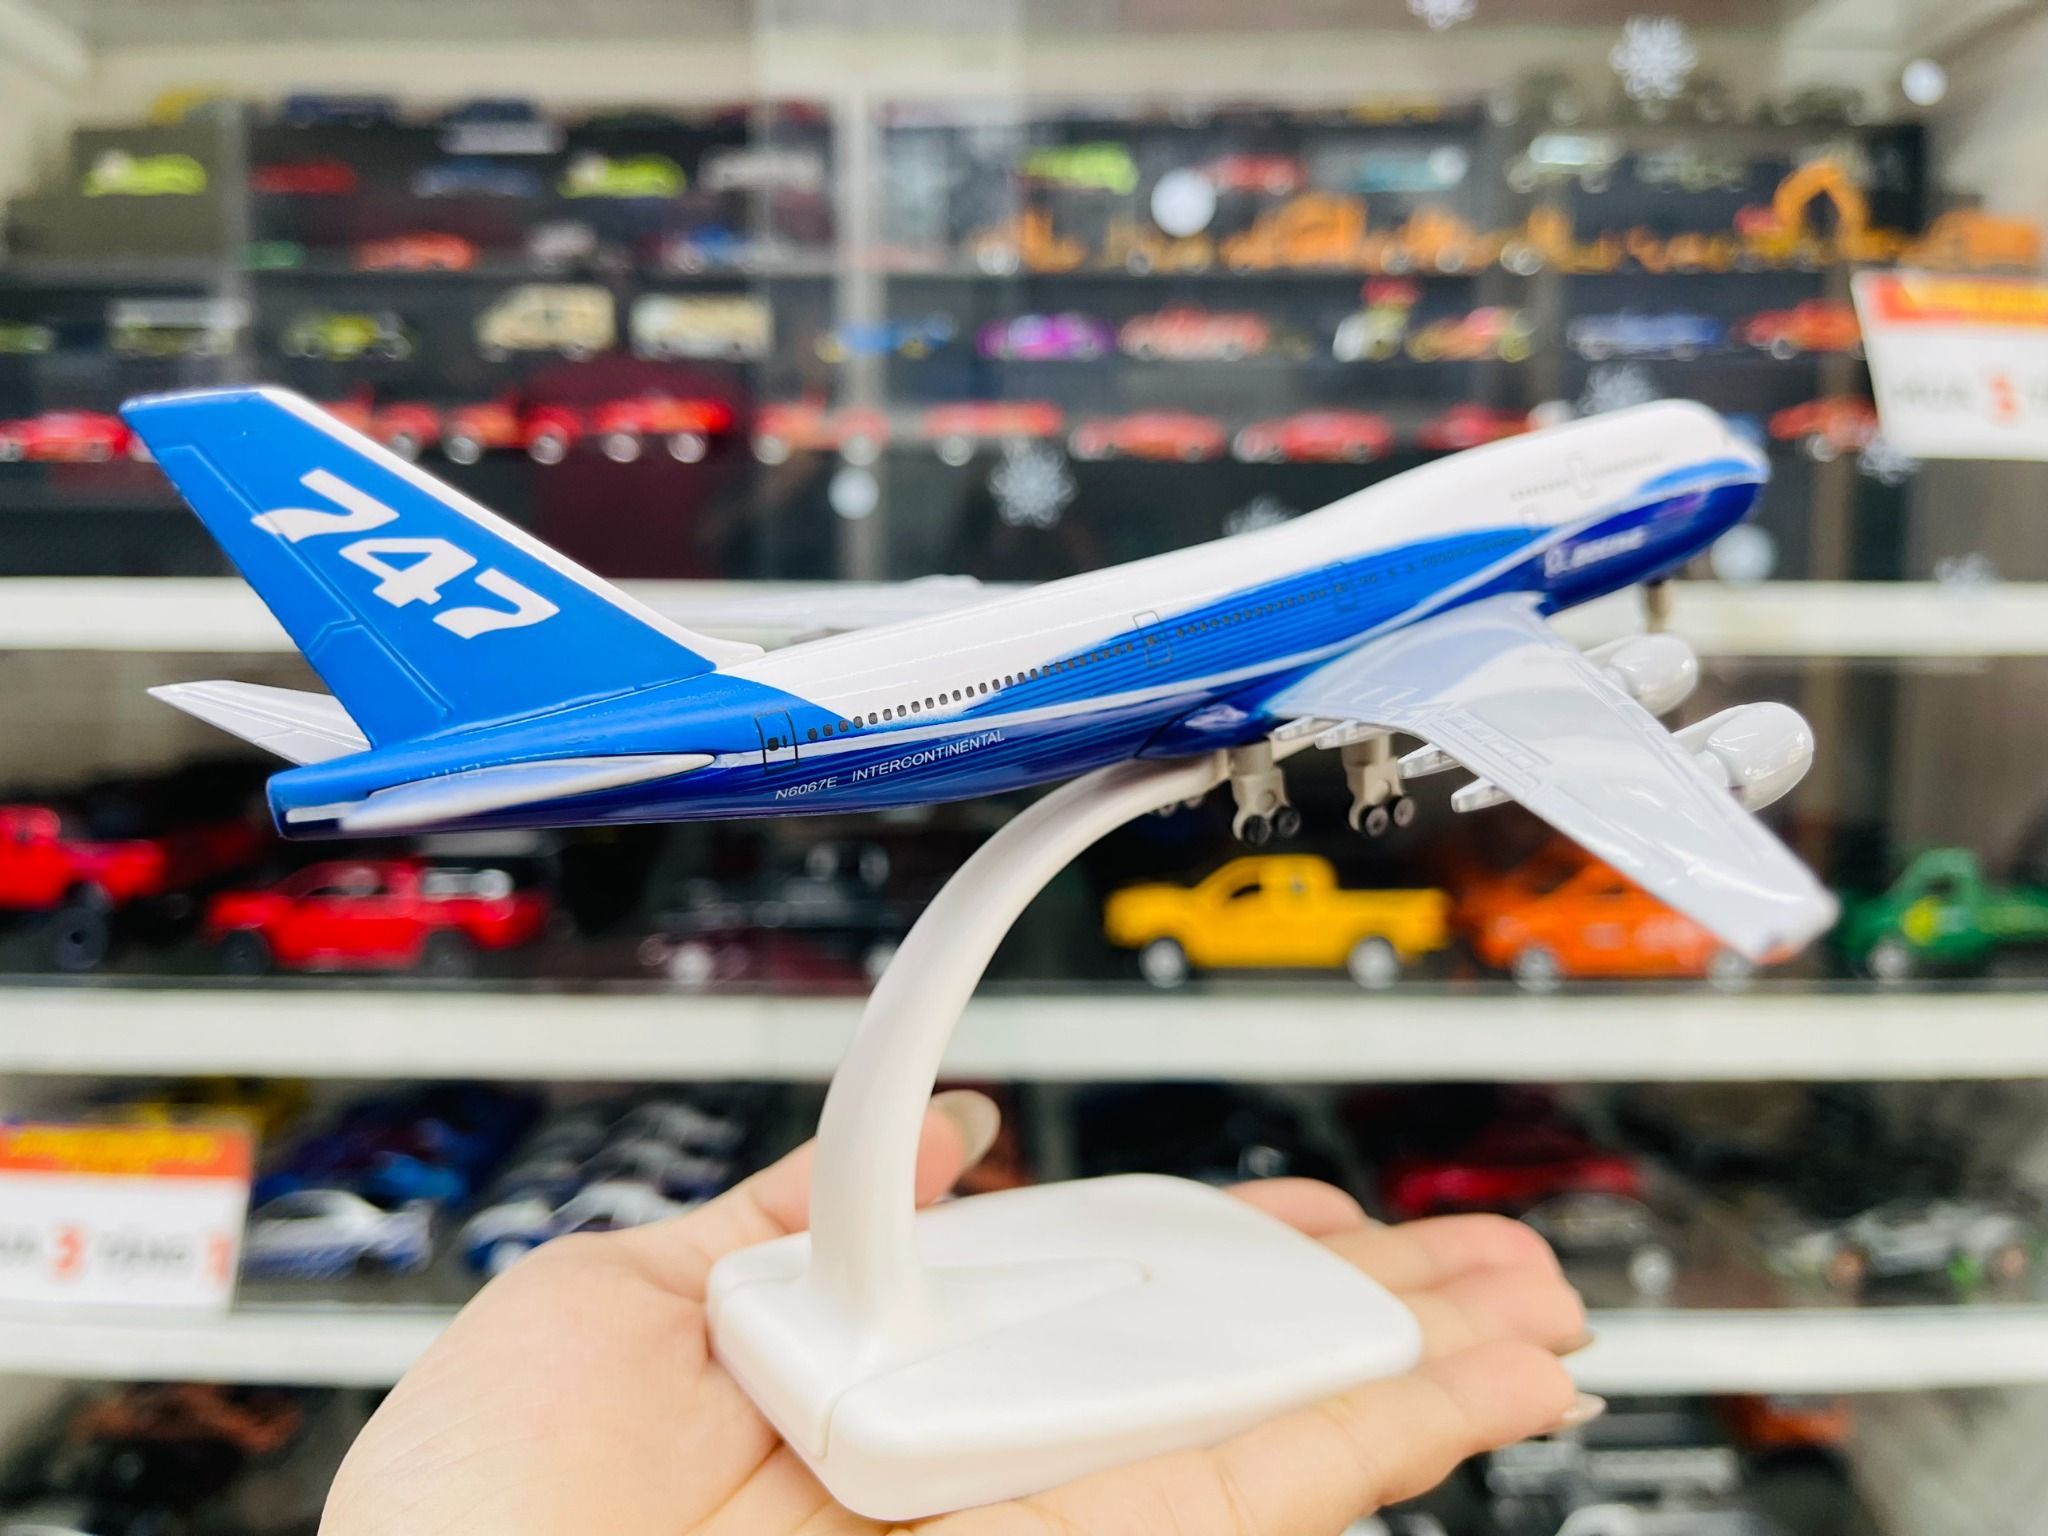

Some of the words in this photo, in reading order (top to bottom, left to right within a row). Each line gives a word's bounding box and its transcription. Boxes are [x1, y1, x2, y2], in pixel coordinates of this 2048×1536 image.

[250, 467, 561, 640] 747
[775, 776, 838, 801] N6067E
[852, 729, 1005, 783] INTERCONTINENTAL
